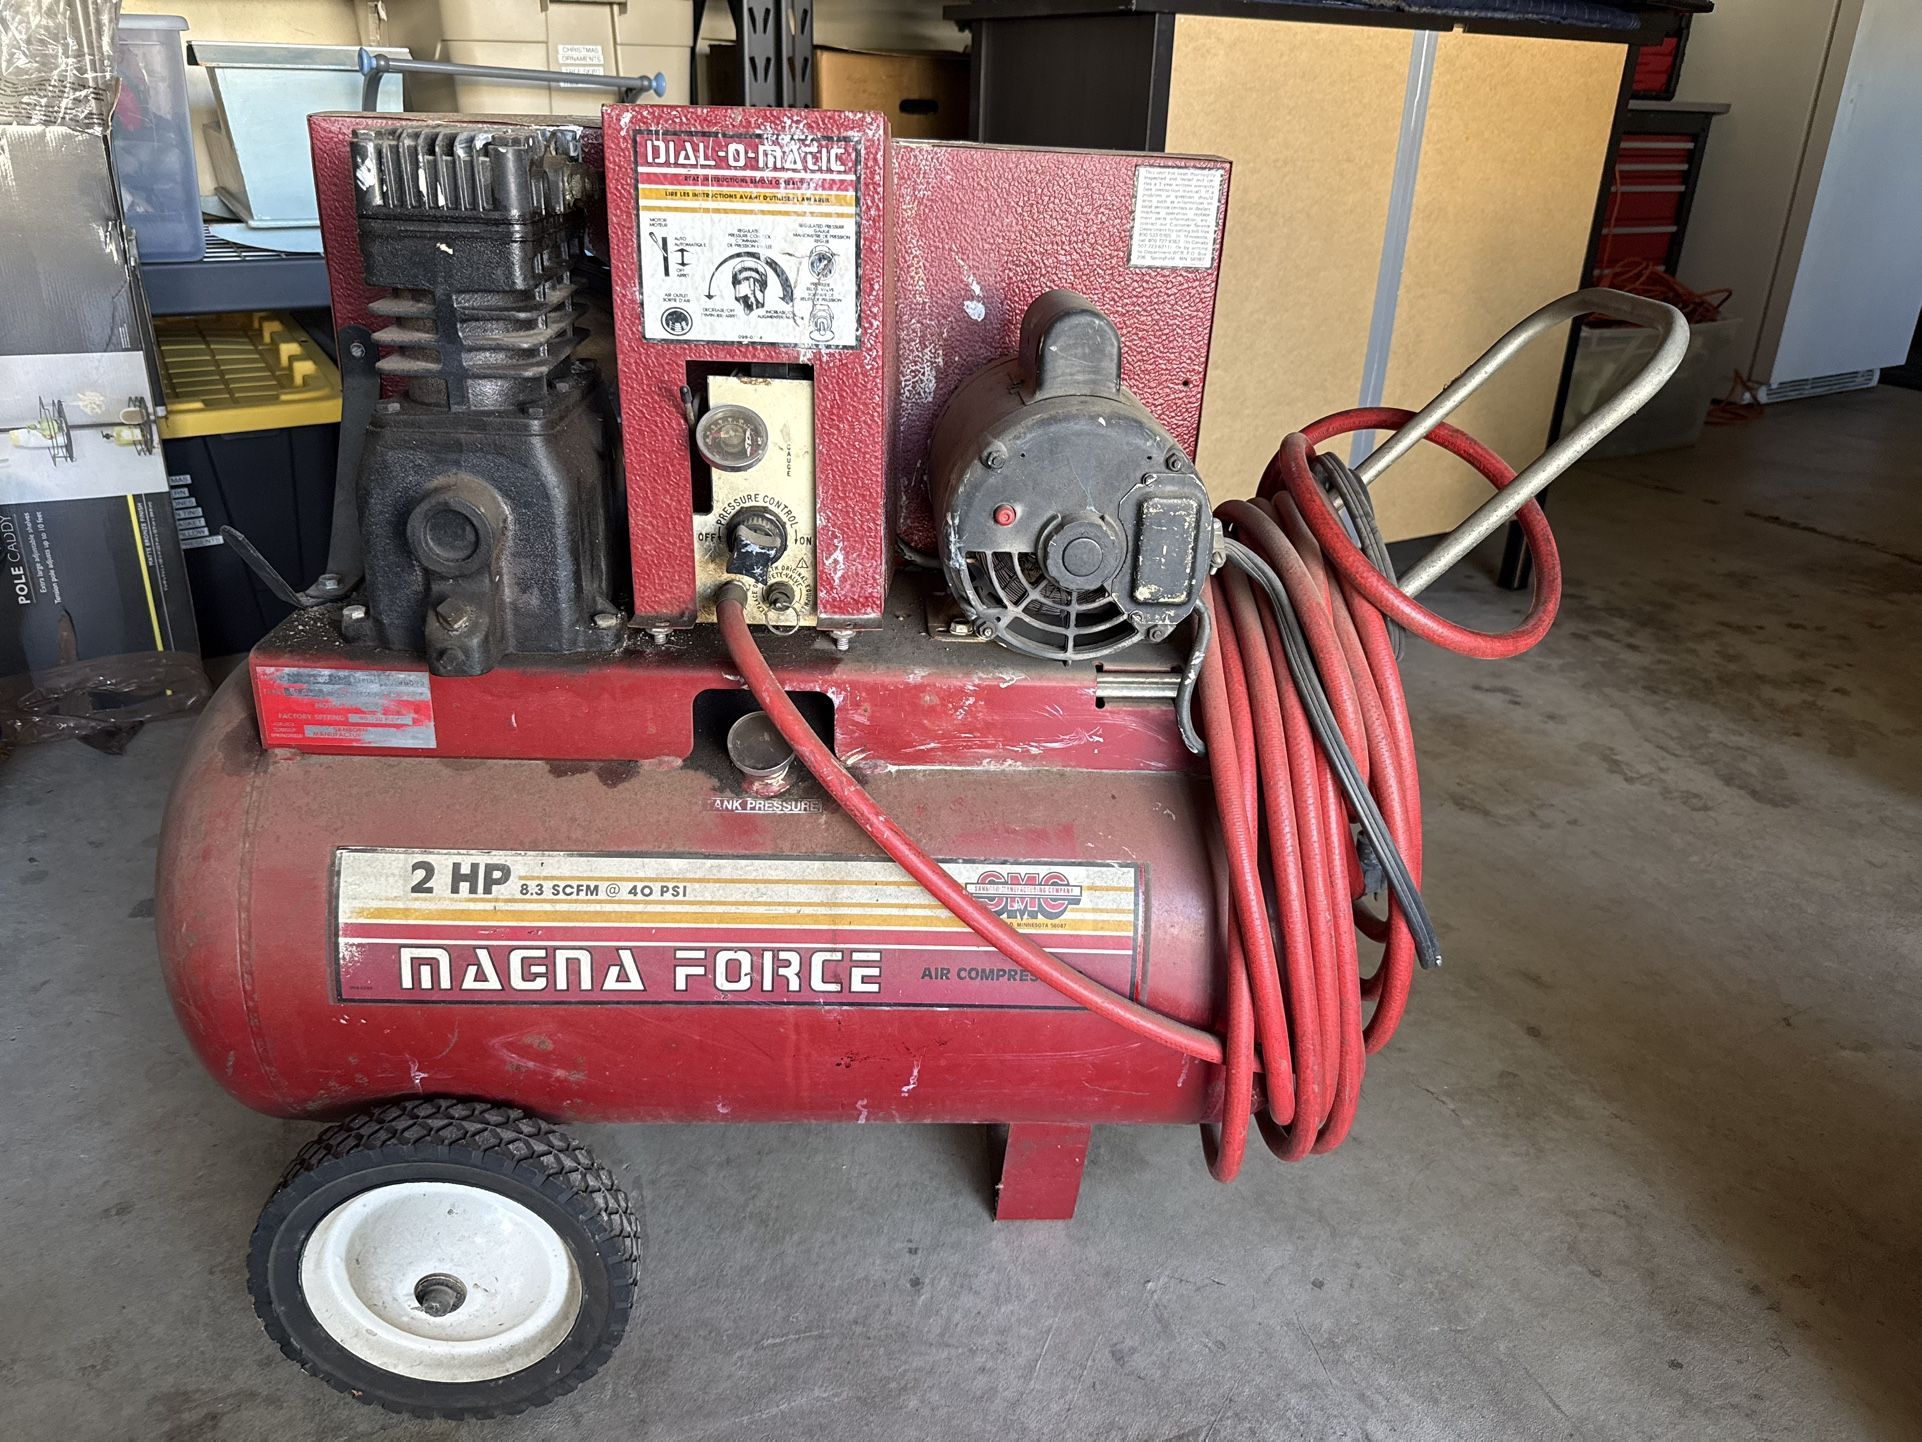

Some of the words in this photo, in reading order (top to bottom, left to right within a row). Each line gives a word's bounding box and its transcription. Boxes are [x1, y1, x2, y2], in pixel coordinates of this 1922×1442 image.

[562, 46, 600, 54] CHRISTMAS
[561, 55, 601, 63] ORNAMENTS
[646, 139, 846, 172] DIAL-O-MATIC
[36, 511, 44, 523] feet
[137, 502, 145, 521] FINISH
[716, 493, 760, 527] PRESSURE
[763, 494, 799, 528] CONTROL
[24, 512, 33, 533] shelves
[37, 523, 45, 531] 10
[0, 516, 20, 562] CADDY
[41, 532, 47, 540] to
[697, 532, 716, 542] OFF
[799, 536, 812, 546] ON
[28, 534, 40, 562] adjustable
[43, 540, 50, 549] up
[45, 549, 54, 569] adjusts
[36, 563, 44, 577] large
[49, 569, 59, 582] pole
[781, 565, 808, 585] ORIGINAL
[11, 566, 31, 604] POLE
[39, 577, 47, 593] Extra
[52, 582, 62, 605] Tension
[714, 800, 742, 811] ANK
[746, 801, 820, 812] PRESSURE
[410, 861, 436, 894] 2
[450, 861, 512, 895] HP
[519, 883, 545, 897] 8.3
[551, 883, 600, 897] SCFM
[605, 883, 621, 898] @
[628, 884, 653, 897] 40
[660, 884, 687, 898] PSI
[400, 946, 647, 992] MAGNA
[673, 947, 882, 994] FORCE
[920, 967, 951, 982] AIR
[956, 967, 1040, 983] COMPRES
